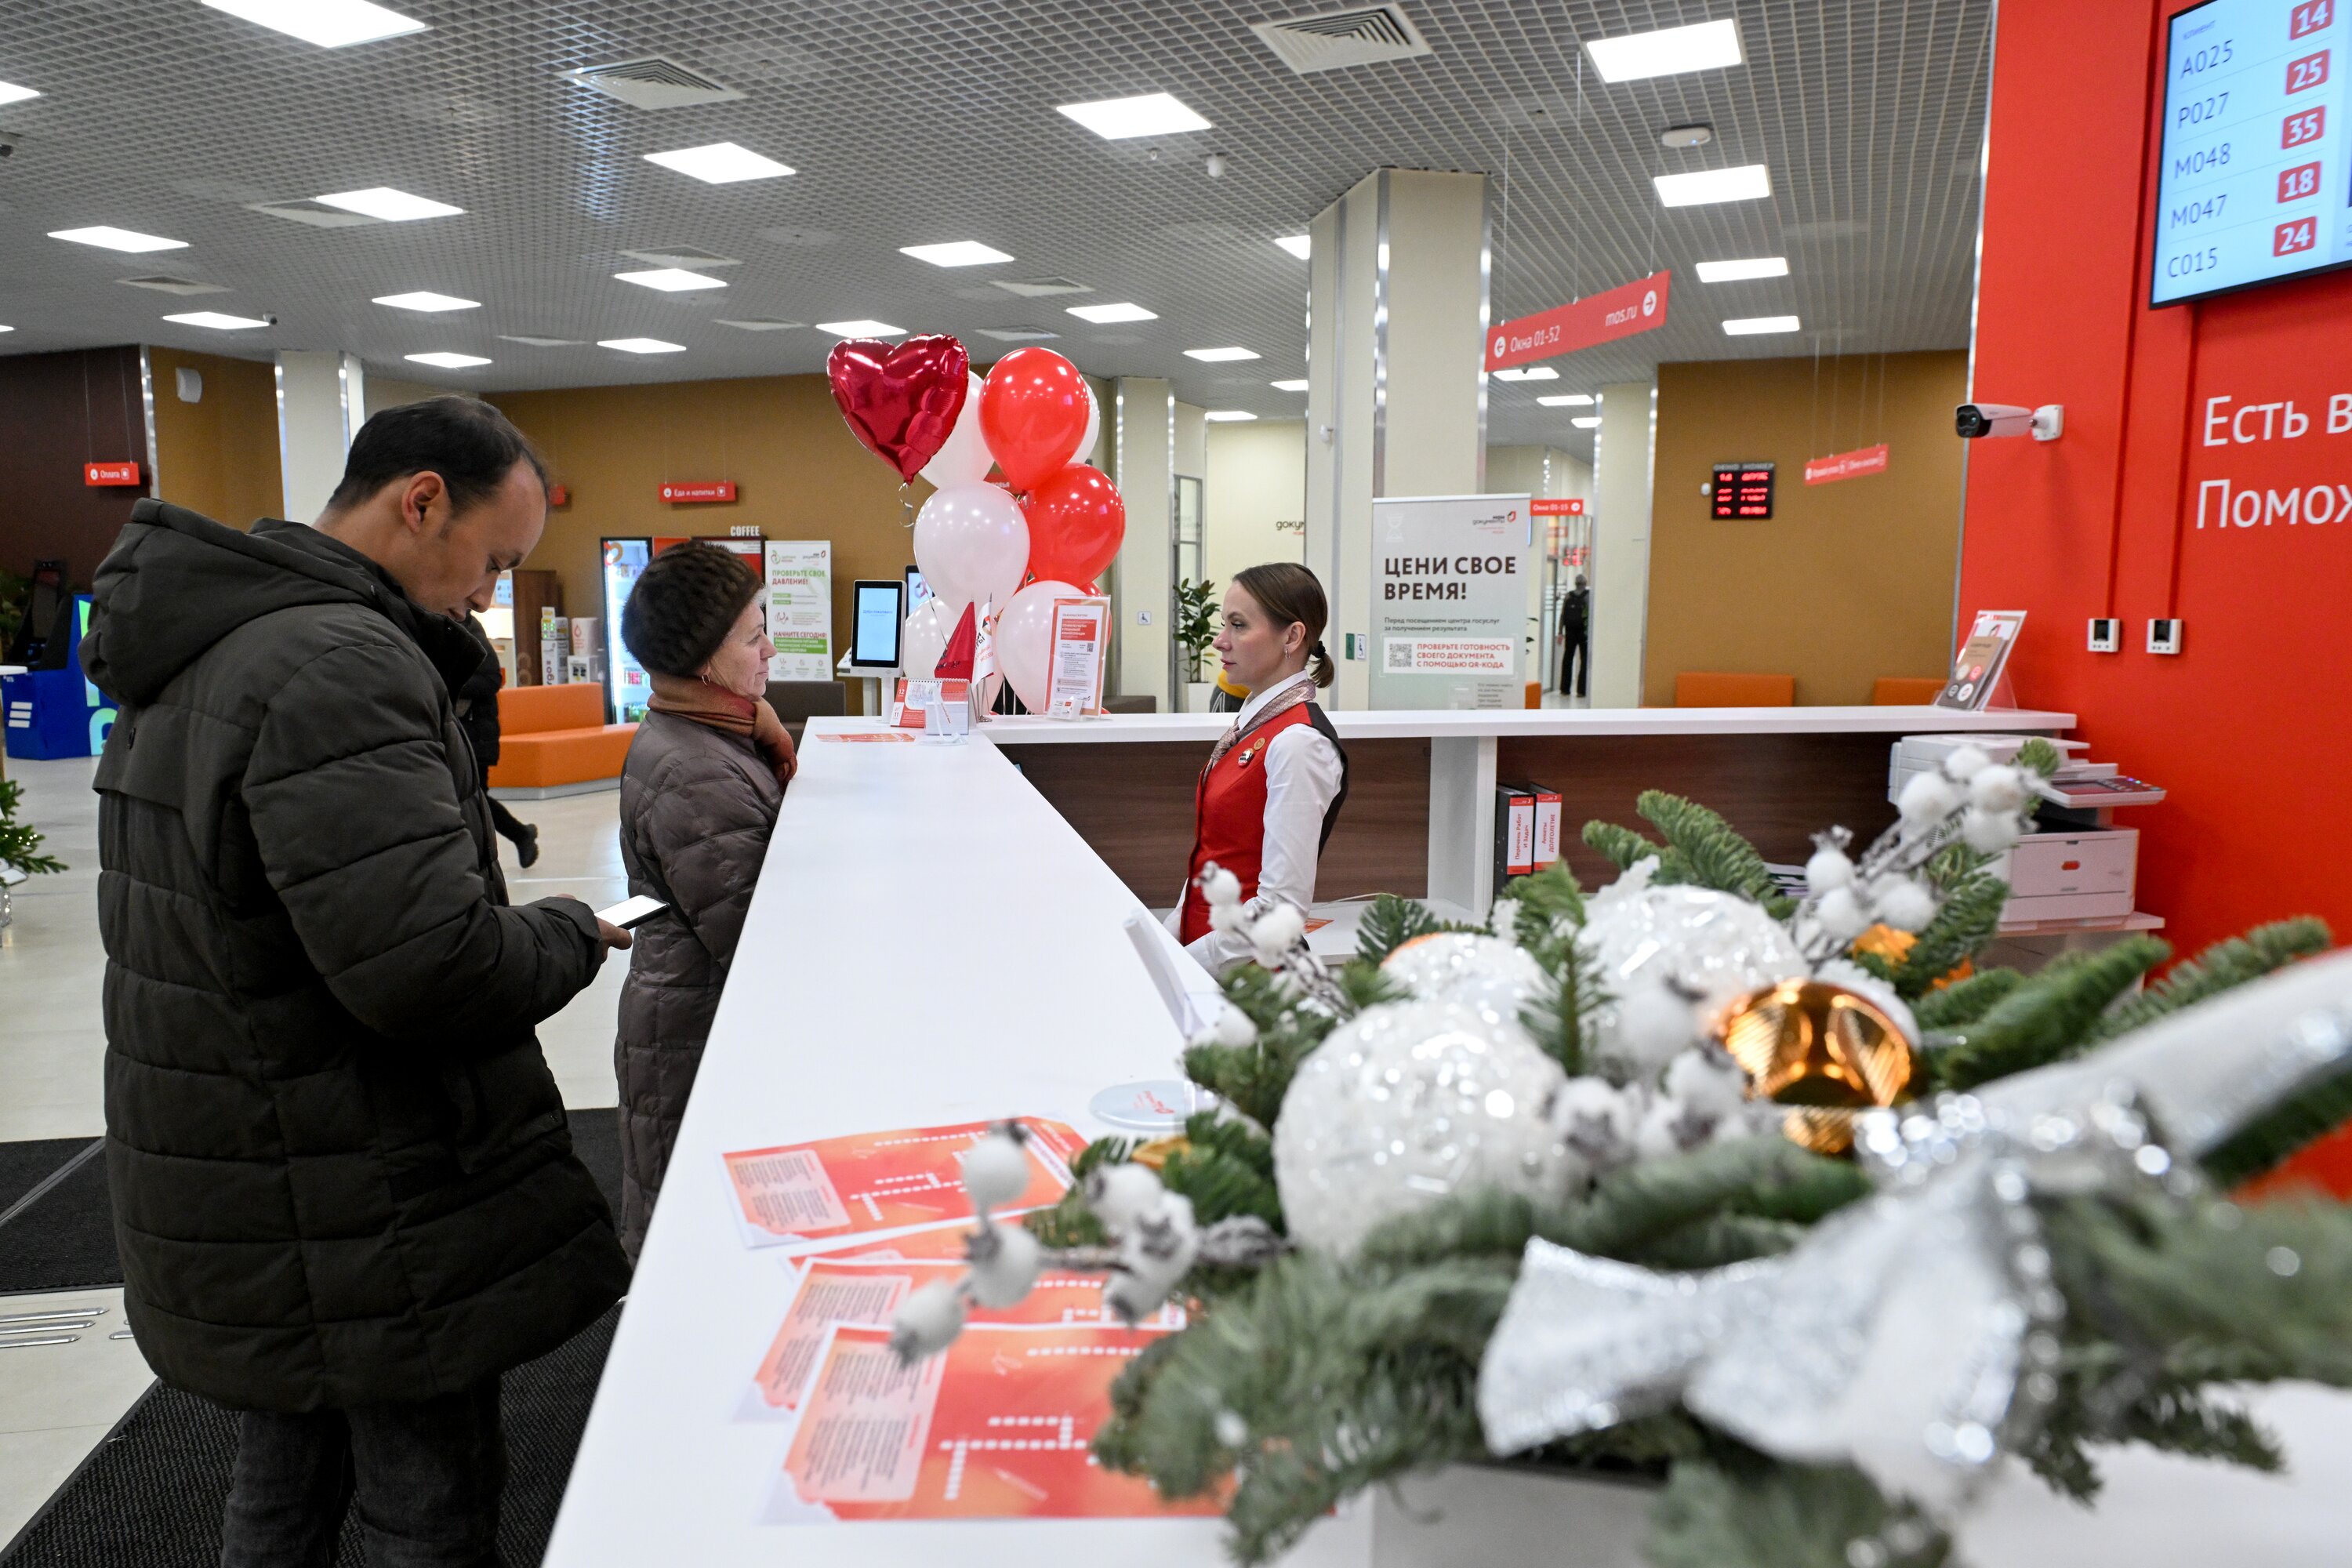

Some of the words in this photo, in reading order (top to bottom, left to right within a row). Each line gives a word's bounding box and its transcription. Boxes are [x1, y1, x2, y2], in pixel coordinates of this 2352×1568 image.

[2296, 1, 2328, 34] 14
[2292, 57, 2324, 89] 25
[2287, 113, 2318, 144] 35
[2284, 168, 2314, 198] 18
[2279, 223, 2310, 252] 24
[1605, 305, 1638, 327] mos.ru
[1510, 336, 1533, 353] Окна
[1534, 325, 1561, 347] 01-52
[2203, 395, 2310, 447] Есть
[730, 525, 760, 536] COFFEE
[1385, 557, 1448, 578] ЦЕНИ
[1454, 556, 1516, 575] СВОЕ
[1385, 582, 1467, 600] ВРЕМЯ!
